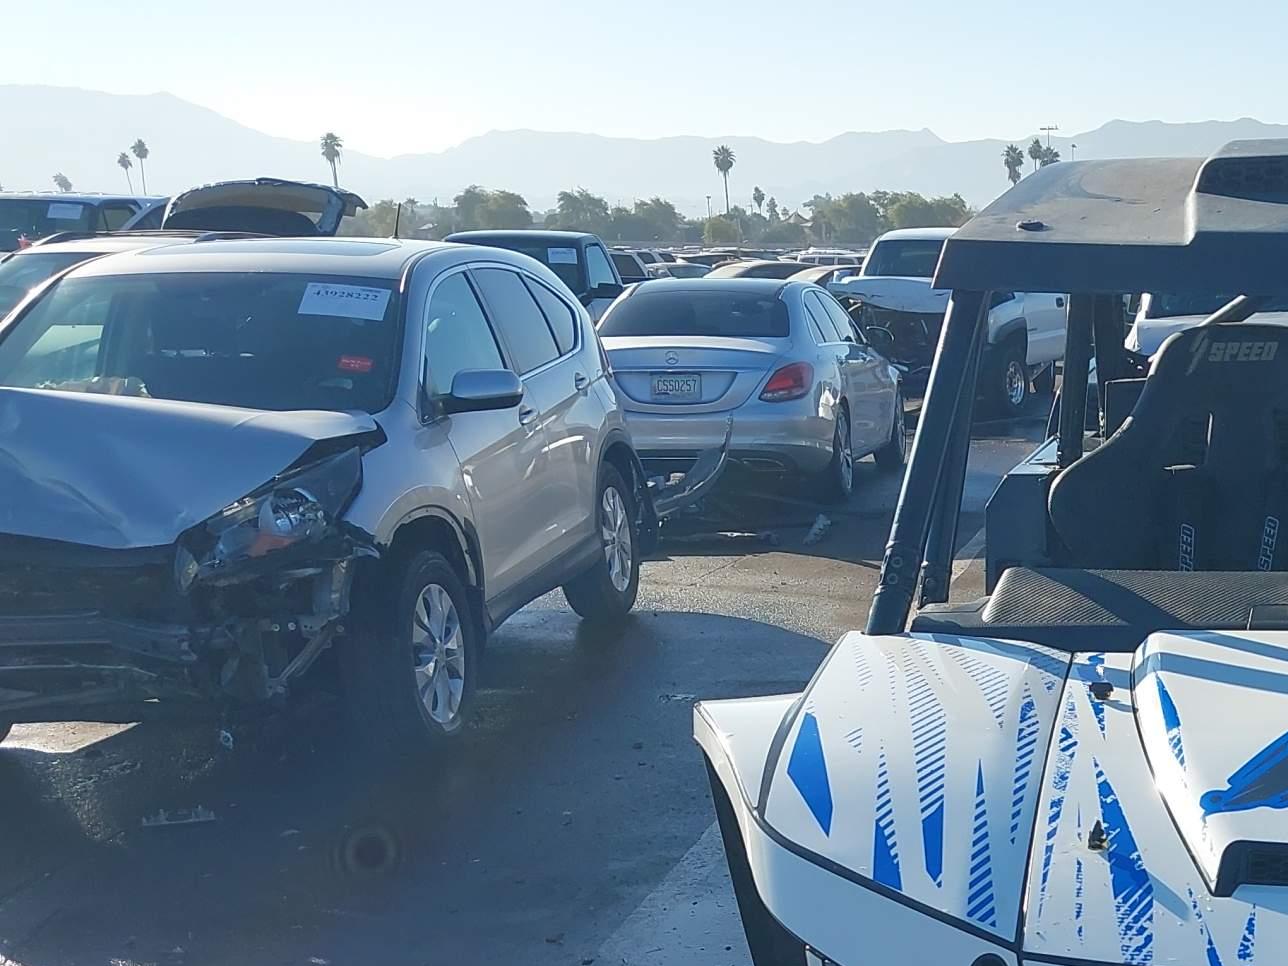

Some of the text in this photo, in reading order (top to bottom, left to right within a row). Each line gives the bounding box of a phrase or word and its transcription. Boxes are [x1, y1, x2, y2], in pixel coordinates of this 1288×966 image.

[312, 289, 379, 301] 43928222
[1208, 341, 1280, 362] SPEED
[1258, 515, 1280, 572] SPEED
